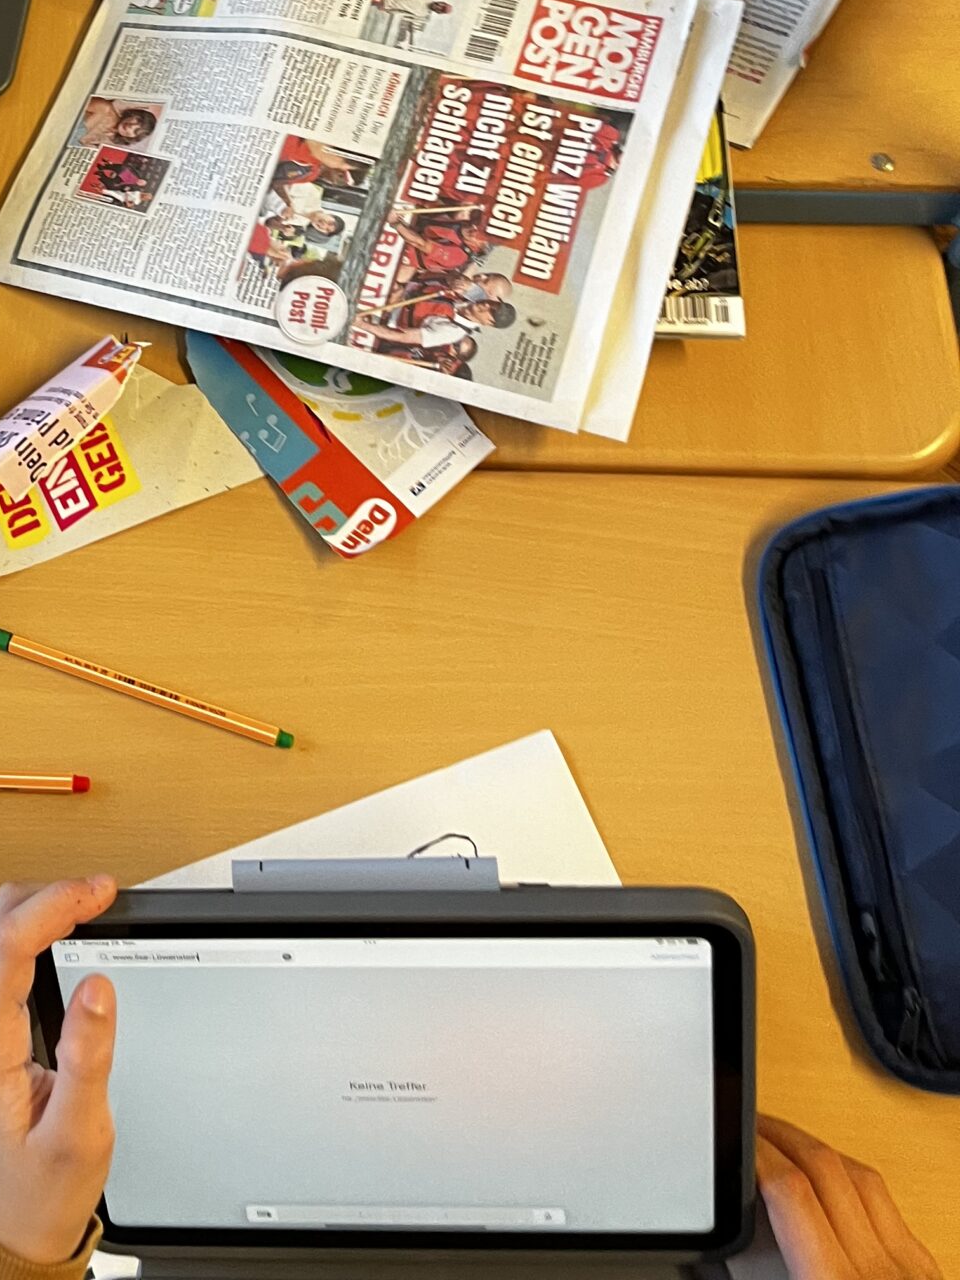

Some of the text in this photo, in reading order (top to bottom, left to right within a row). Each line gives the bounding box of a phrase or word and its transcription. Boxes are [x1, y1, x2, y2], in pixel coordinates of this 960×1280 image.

[337, 2, 350, 17] York
[553, 3, 609, 88] GEN
[590, 11, 641, 96] MOR
[624, 17, 658, 100] HAMBURGER
[323, 61, 356, 133] Drachenbootrennen
[345, 94, 360, 115] beim
[350, 100, 373, 144] Thronfolger
[369, 71, 401, 135] KÖNIGLICH Der
[404, 81, 475, 204] schlagen
[455, 92, 515, 196] nicht zu
[485, 102, 557, 242] ist einfach
[551, 112, 599, 181] Prinz
[521, 181, 577, 281] William
[286, 289, 309, 326] Post
[305, 286, 332, 335] Promi-
[341, 503, 391, 553] Dein
[349, 1081, 427, 1091] Keine Treffer
